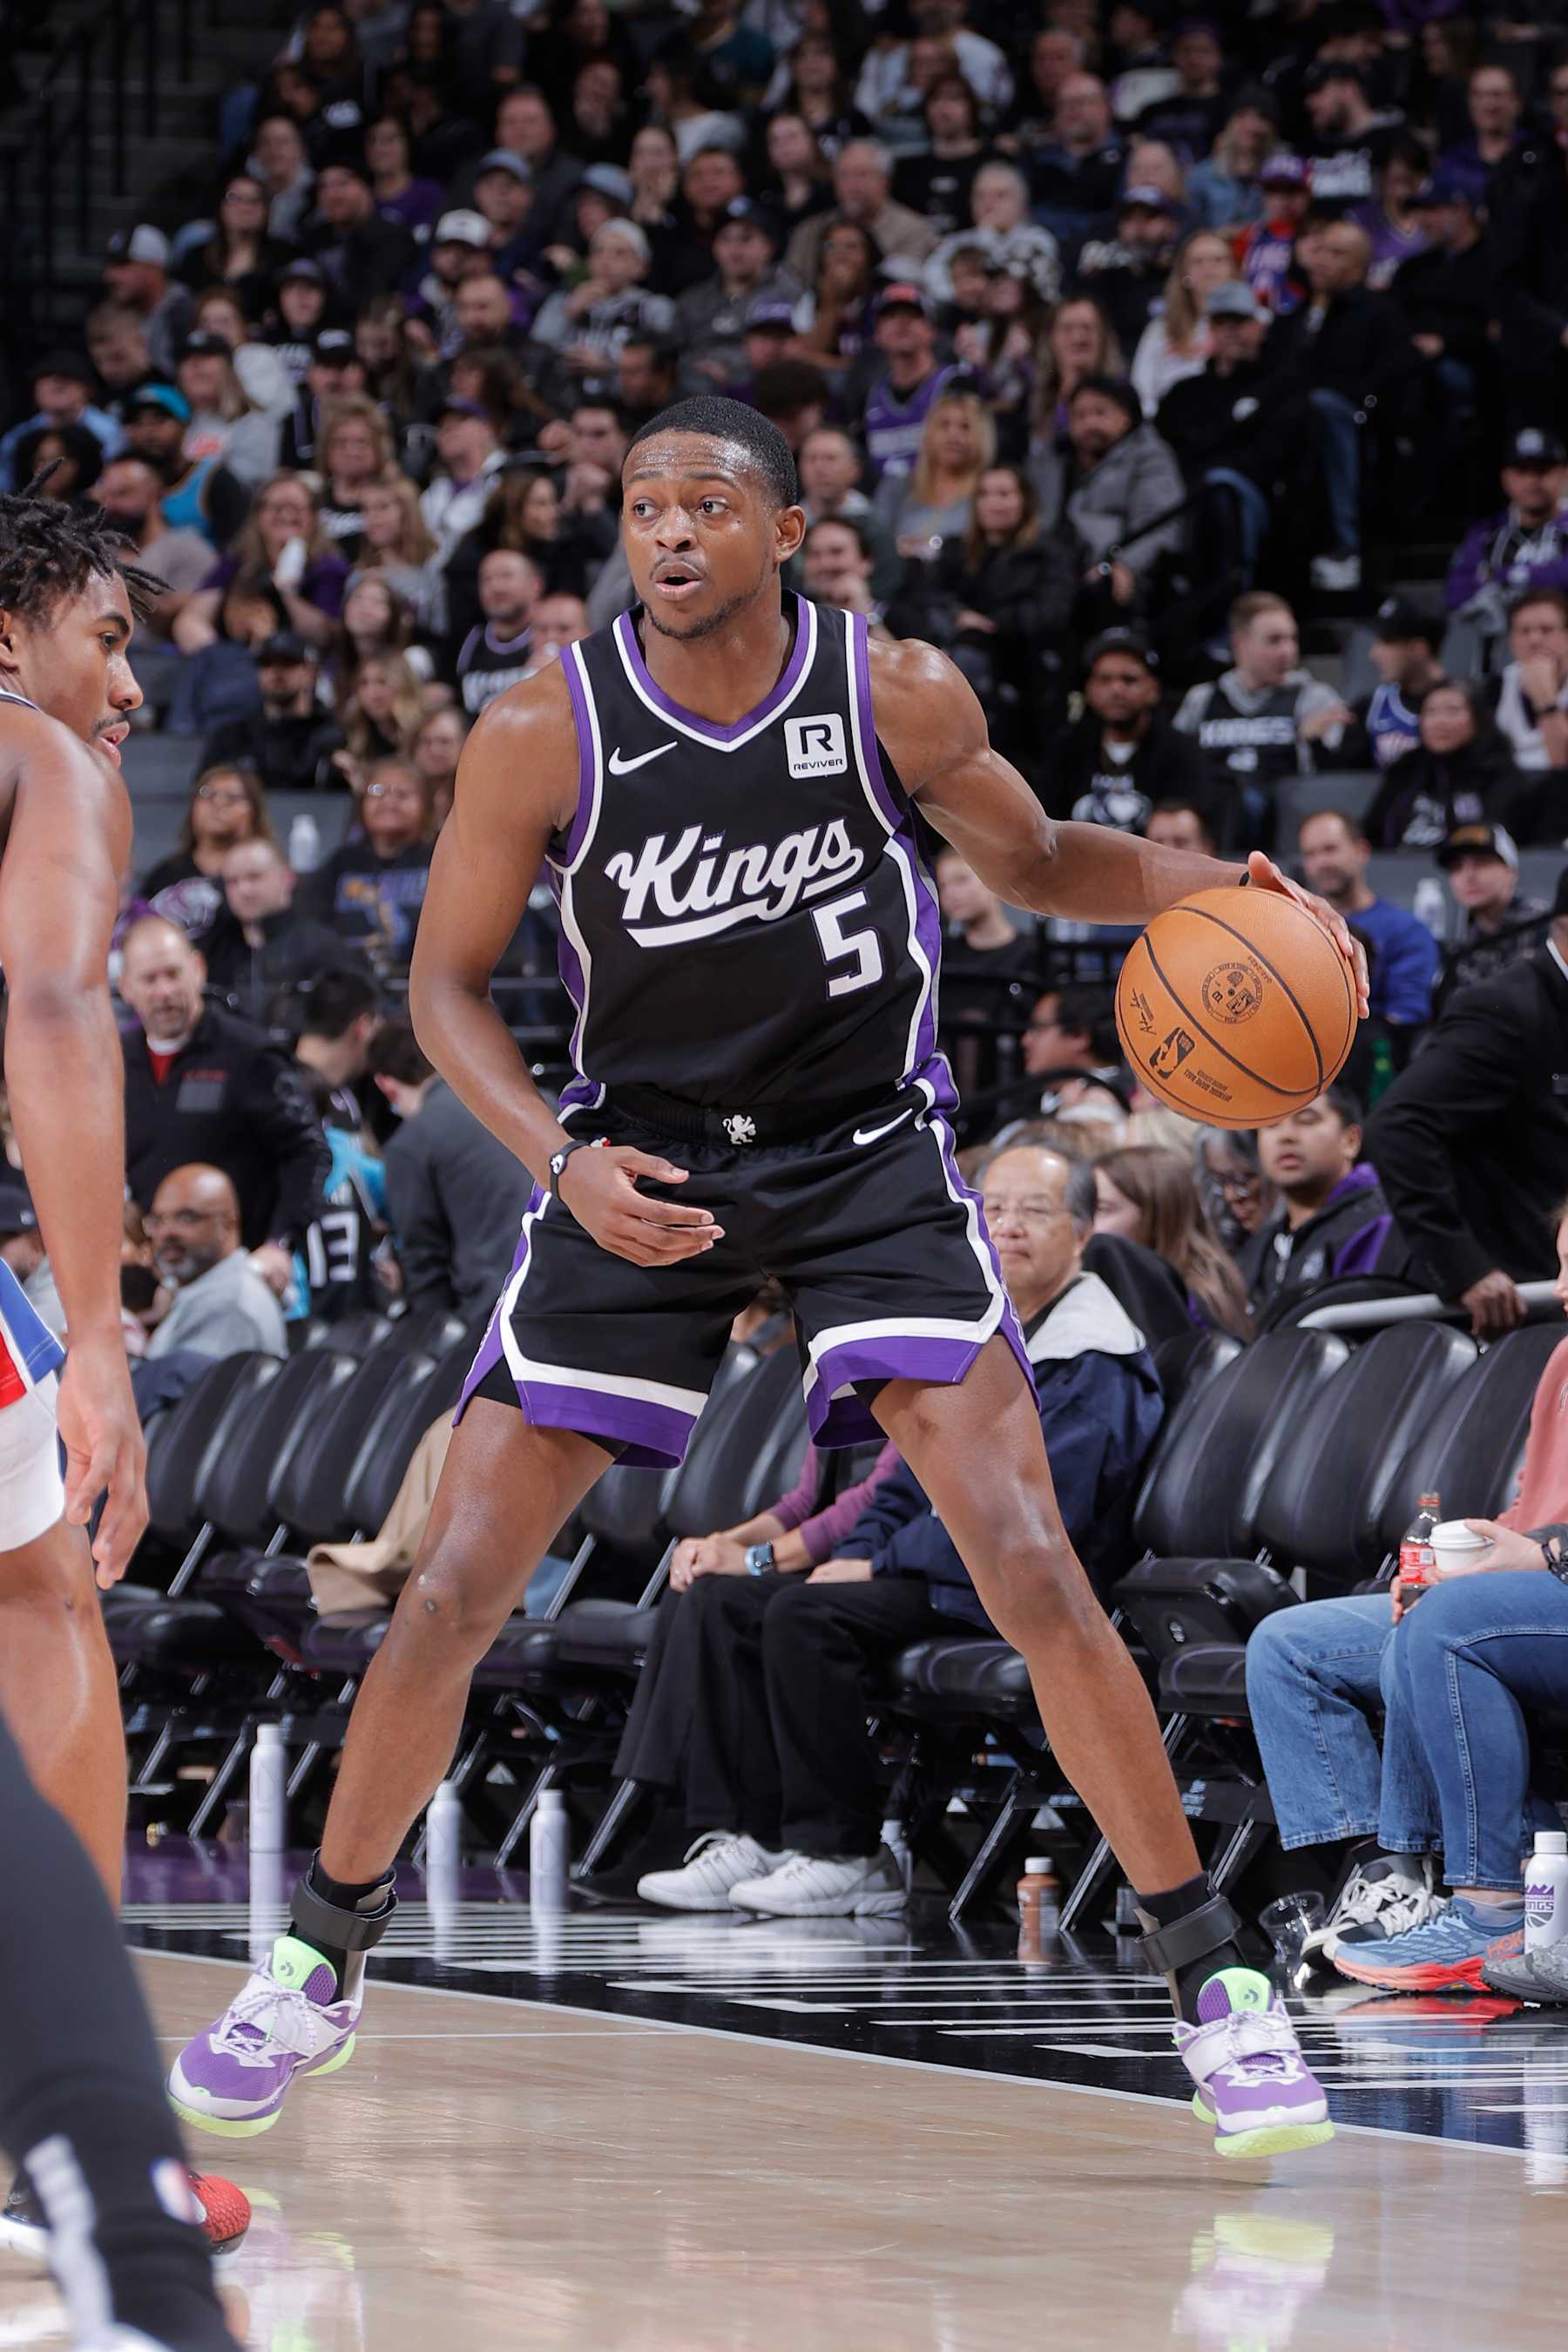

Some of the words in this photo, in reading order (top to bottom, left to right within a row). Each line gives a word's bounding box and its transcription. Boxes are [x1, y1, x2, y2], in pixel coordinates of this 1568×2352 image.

[793, 758, 843, 772] REVIVER
[799, 724, 834, 754] R
[605, 817, 864, 948] Kings
[813, 889, 883, 998] 5
[307, 1211, 360, 1288] 13
